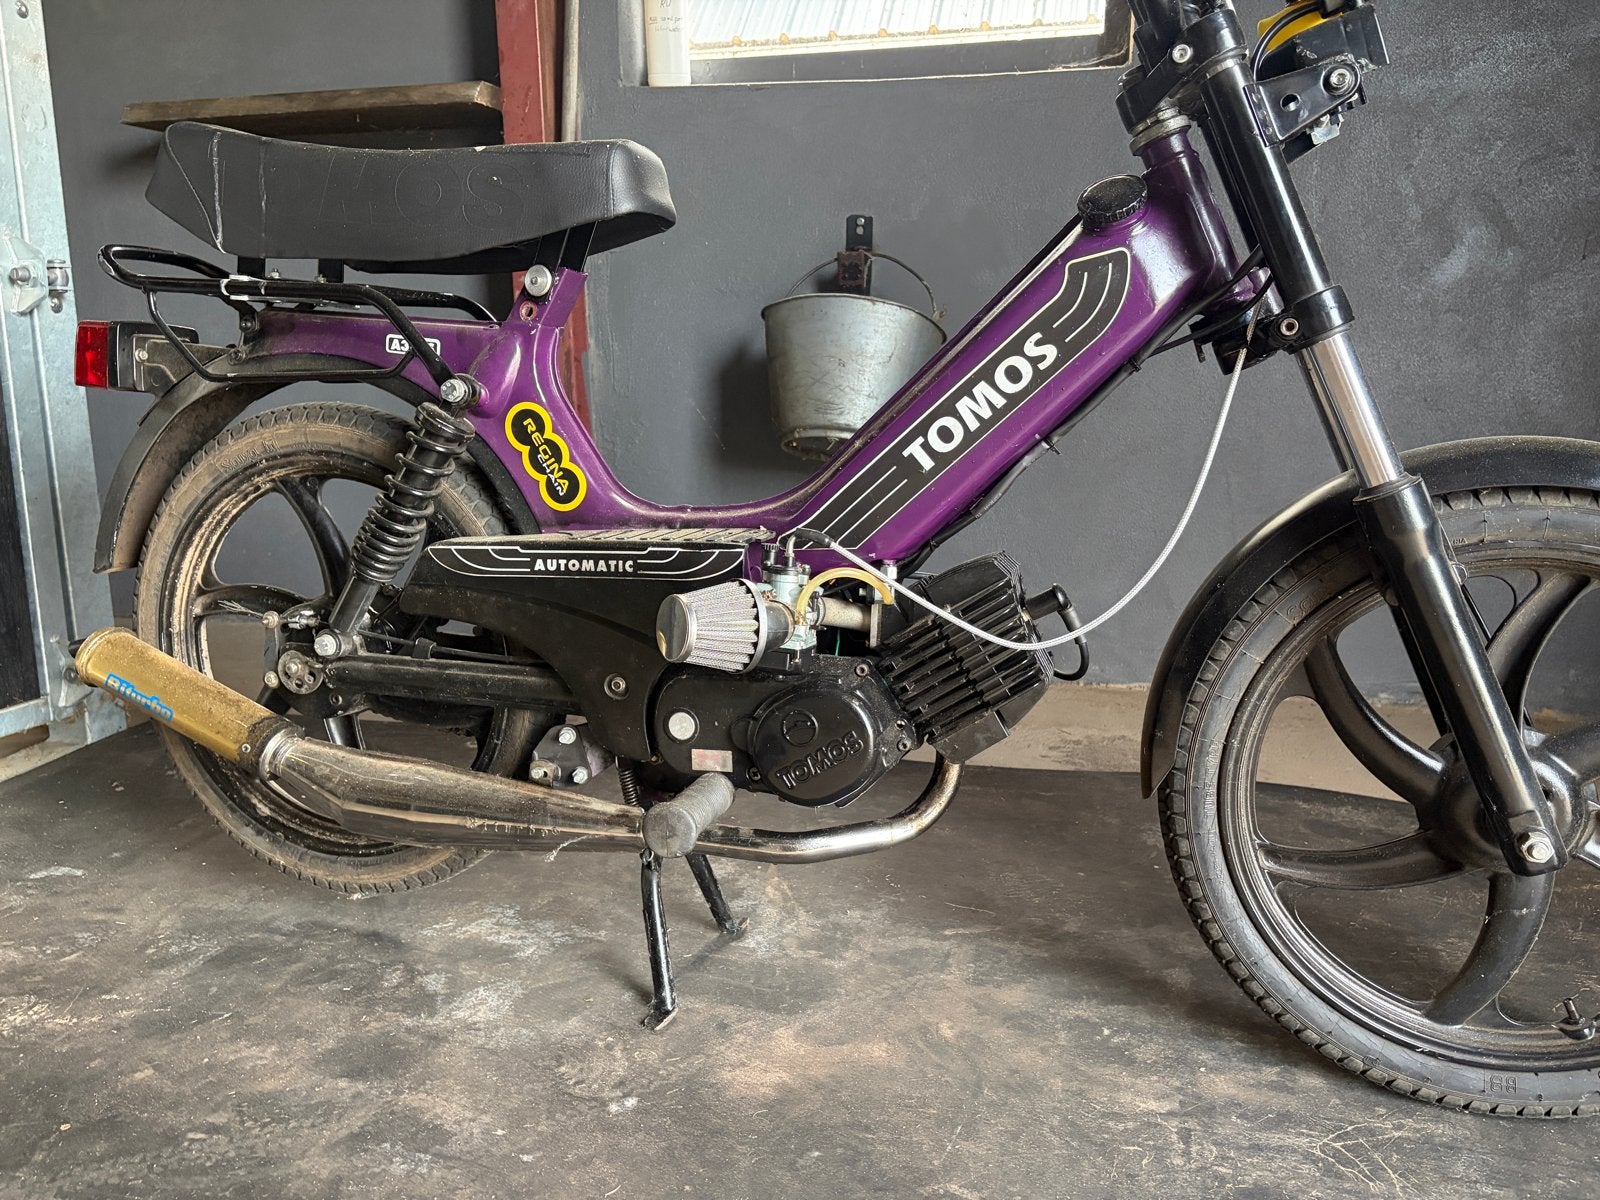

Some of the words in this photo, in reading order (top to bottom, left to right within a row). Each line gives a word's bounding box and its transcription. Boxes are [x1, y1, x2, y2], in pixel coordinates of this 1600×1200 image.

[902, 332, 1058, 471] TOMOS
[523, 417, 569, 494] REGINA
[537, 453, 565, 496] CHAIN
[533, 558, 634, 573] AUTOMATIC
[776, 730, 865, 789] TOMOS
